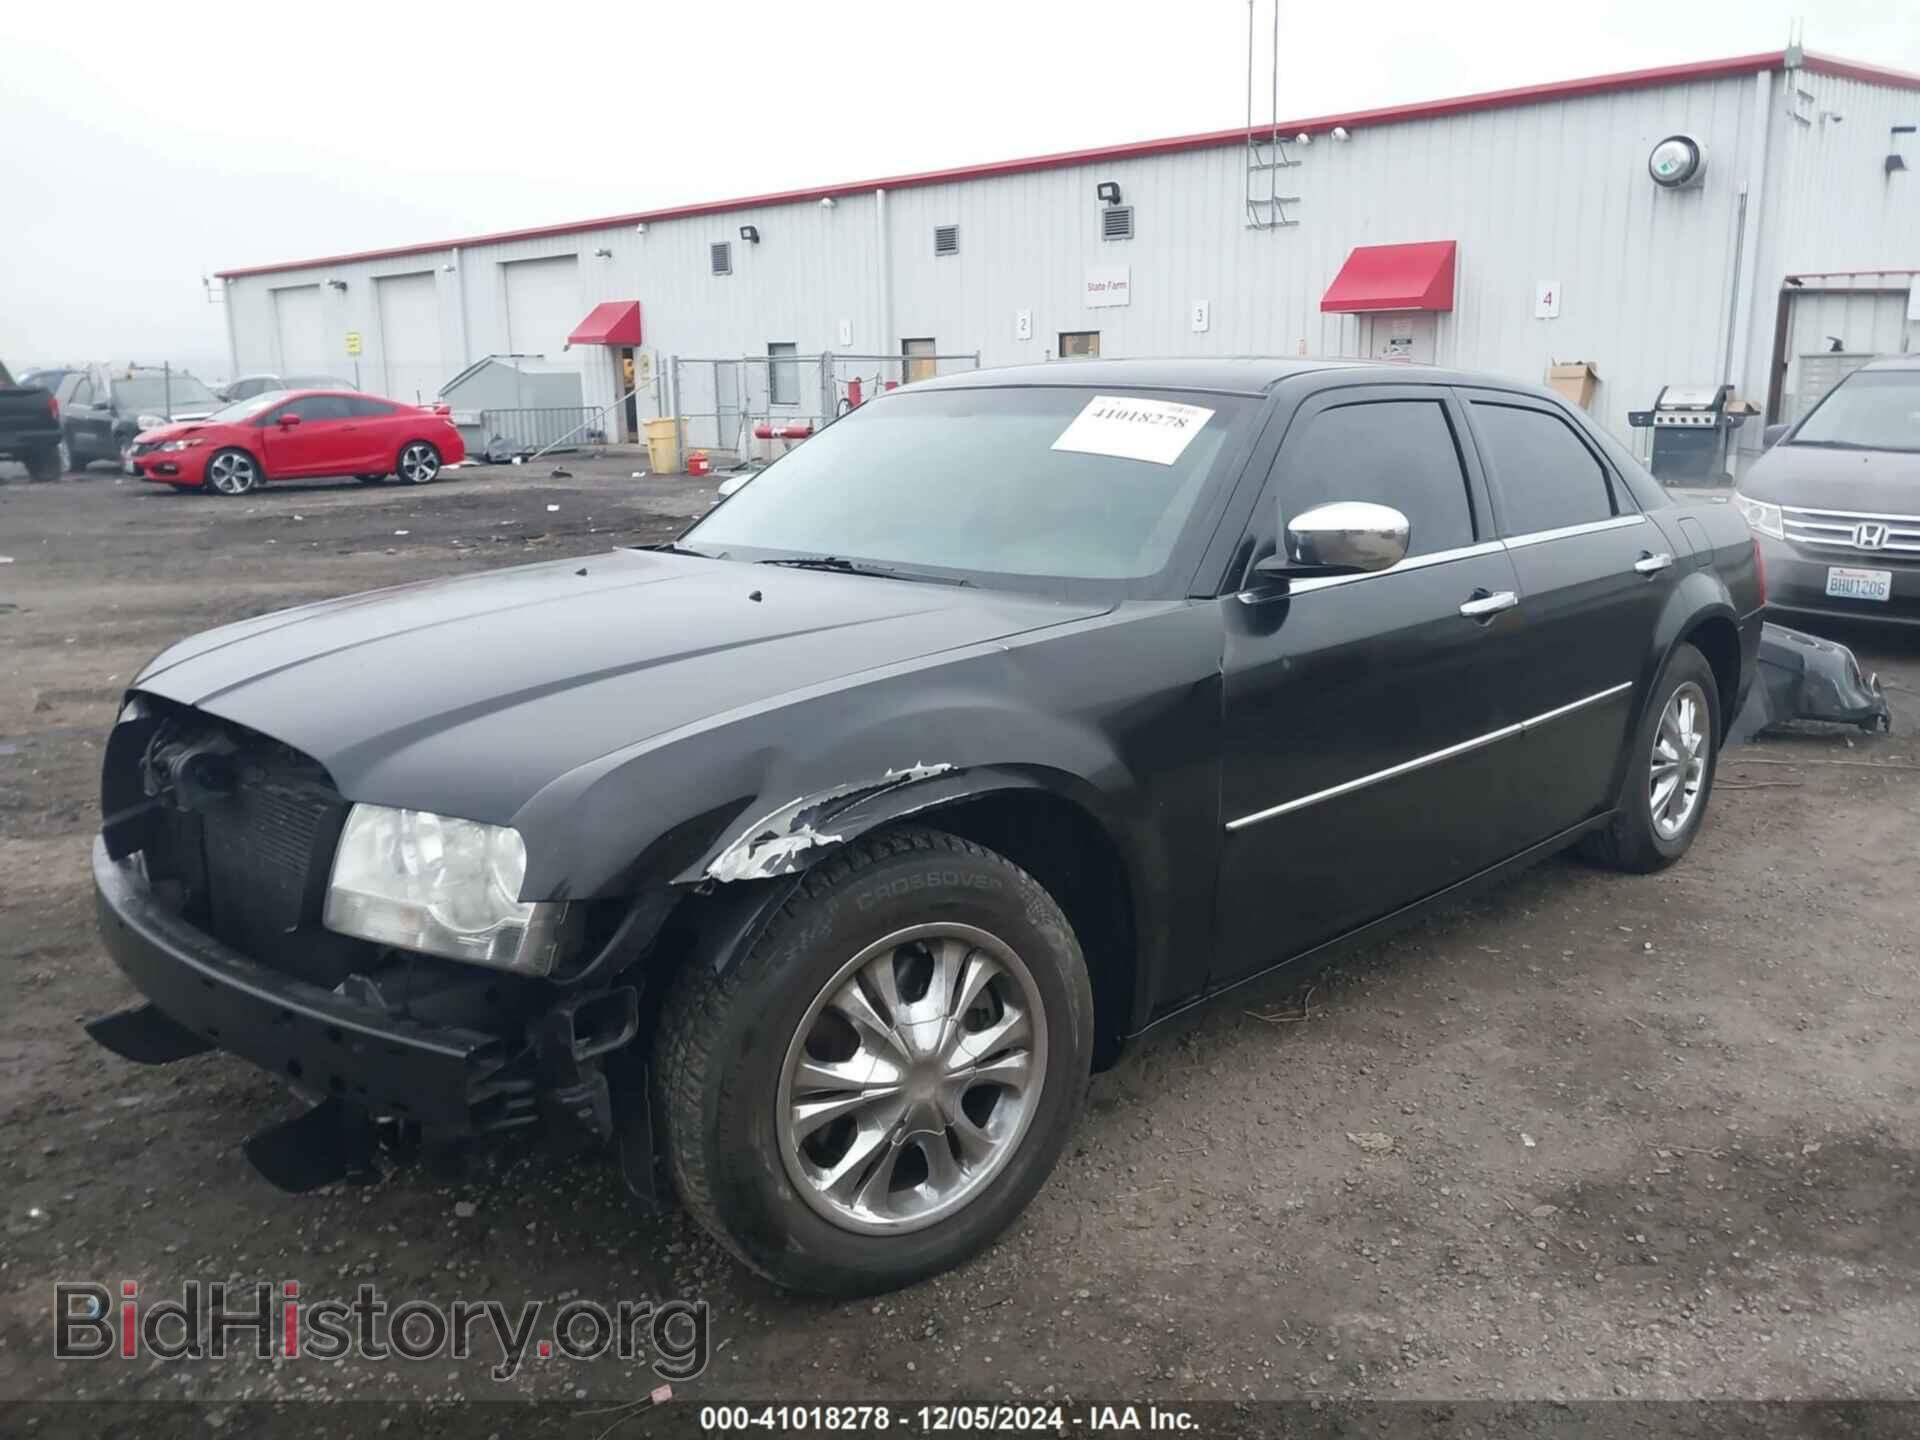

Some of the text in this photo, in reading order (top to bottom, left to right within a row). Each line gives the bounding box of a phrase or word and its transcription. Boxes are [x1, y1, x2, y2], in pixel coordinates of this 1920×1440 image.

[1087, 280, 1128, 292] State Farm
[1543, 290, 1553, 308] 4
[1196, 309, 1204, 323] 3
[1020, 318, 1027, 331] 2
[1093, 408, 1189, 429] 41018278
